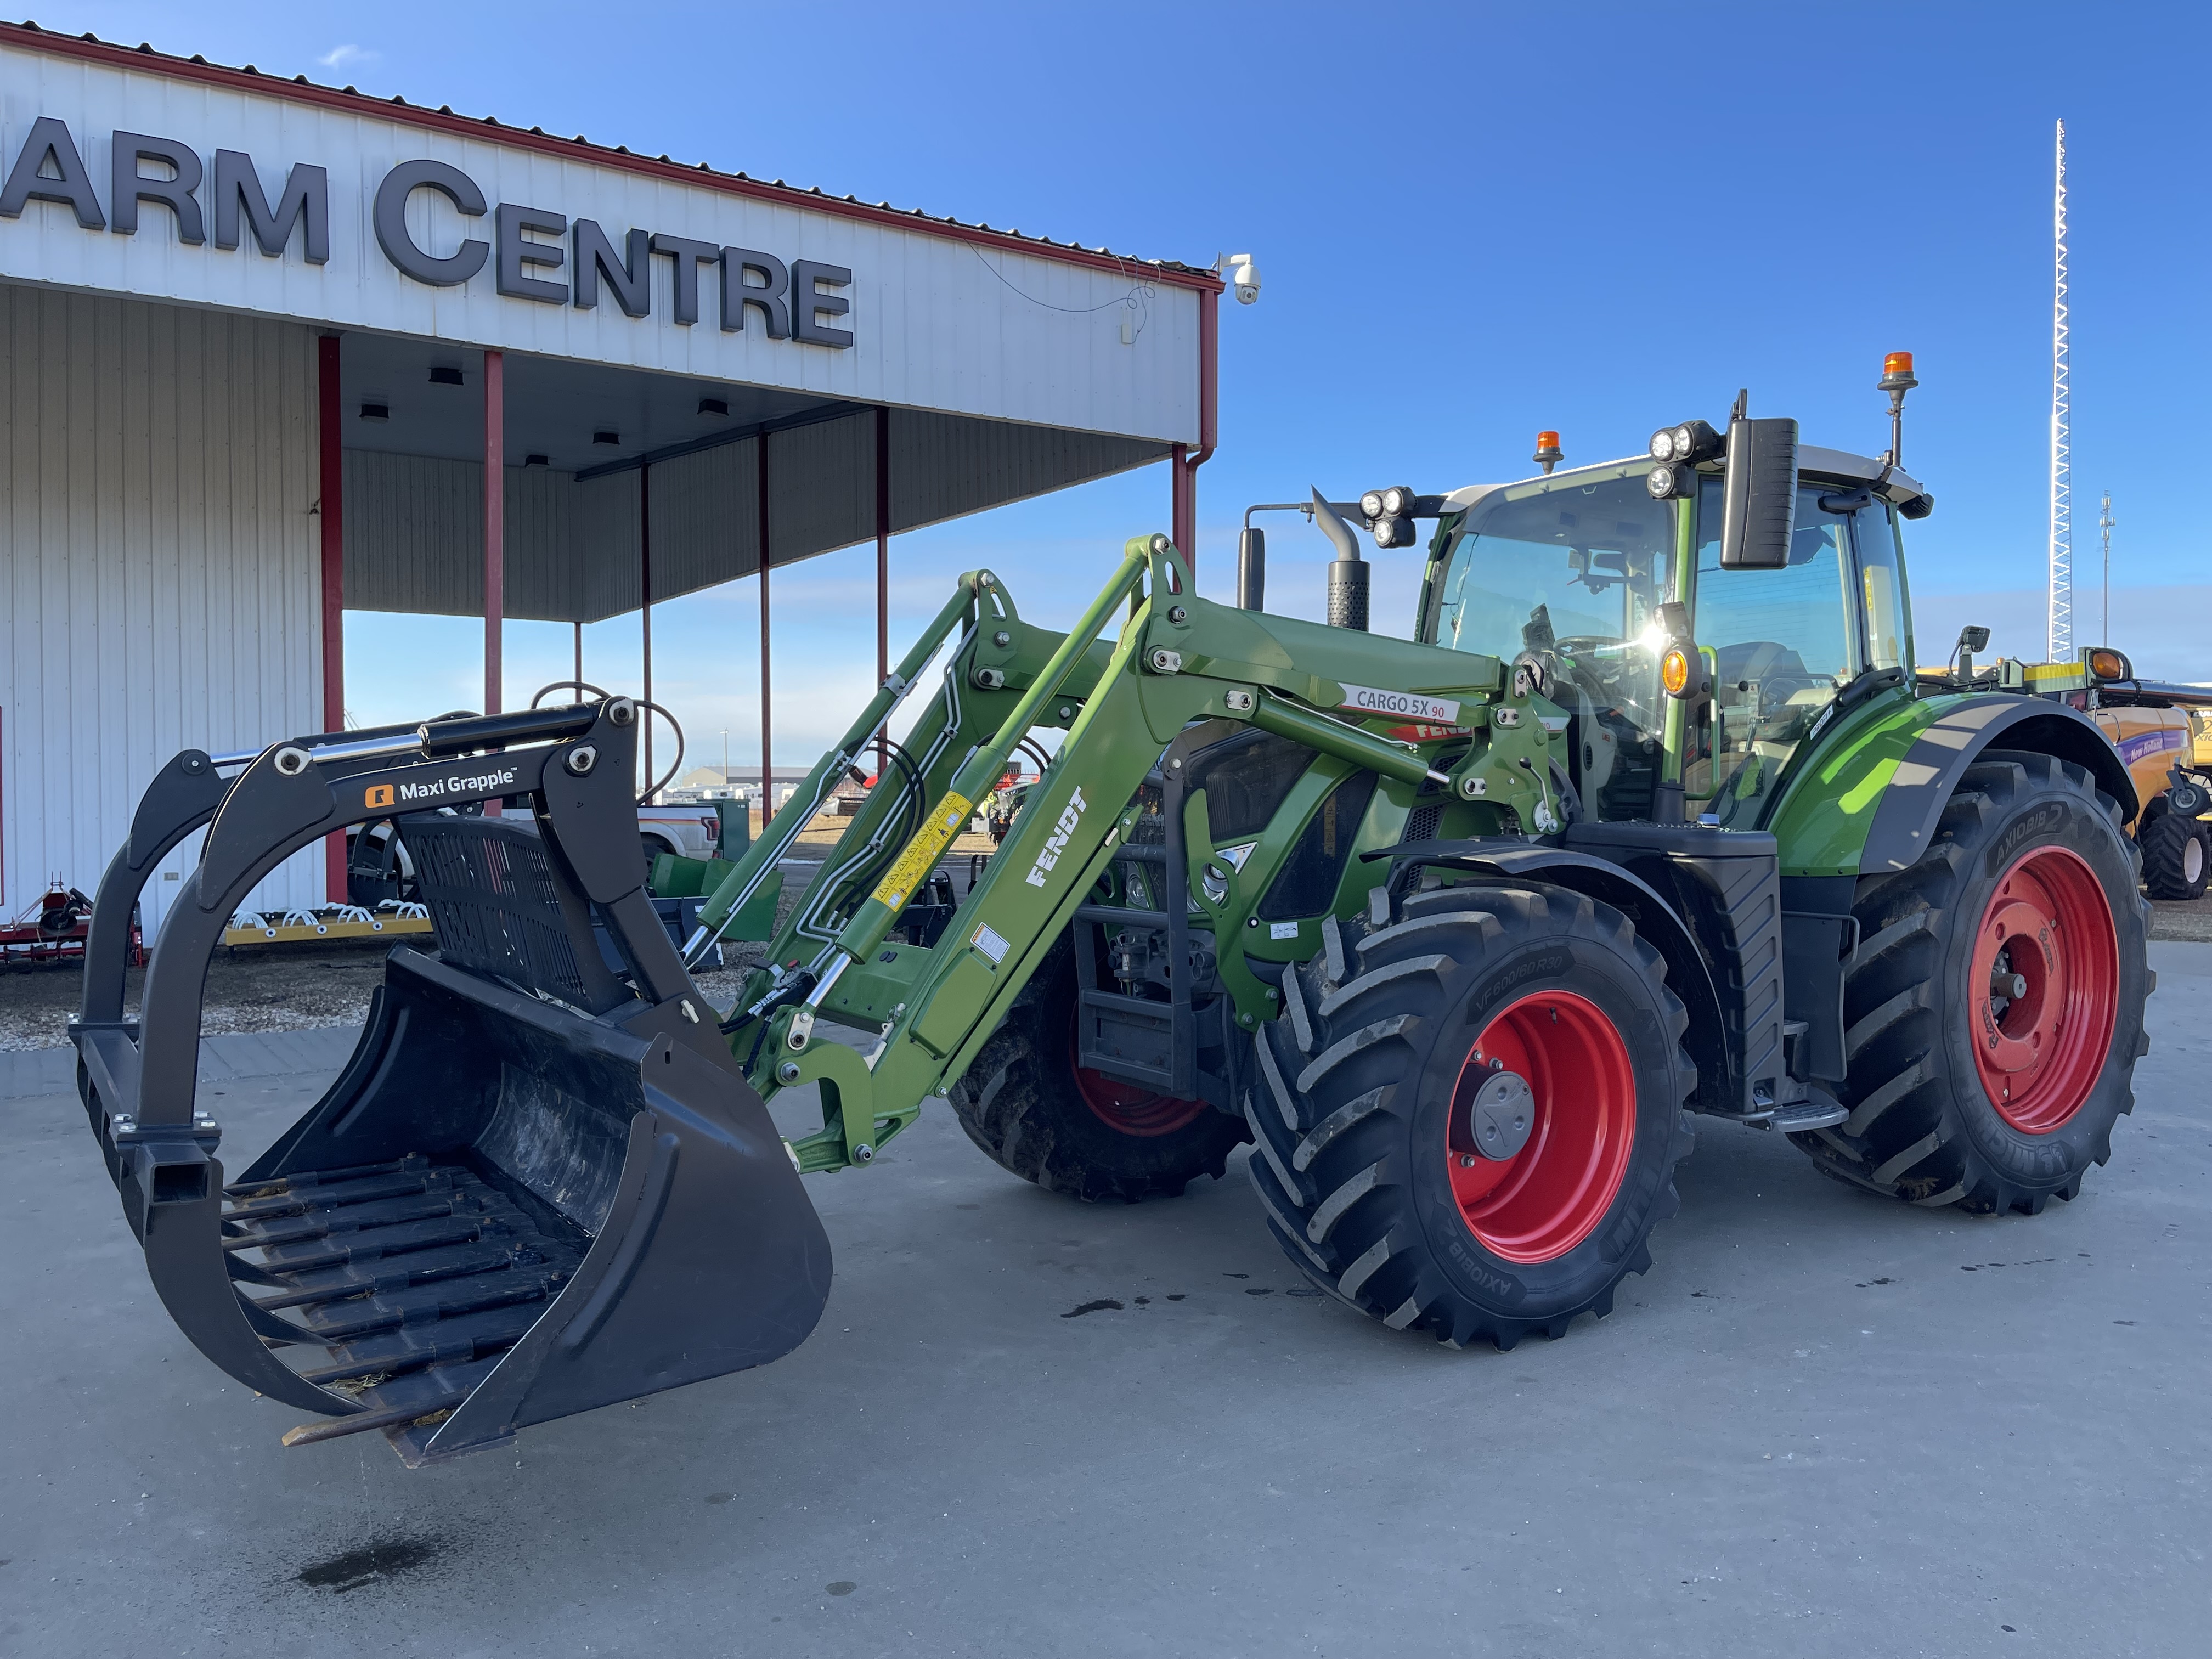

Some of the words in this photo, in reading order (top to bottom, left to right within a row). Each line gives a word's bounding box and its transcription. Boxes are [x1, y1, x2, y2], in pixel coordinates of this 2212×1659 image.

[0, 116, 329, 266] ARM
[374, 159, 854, 349] CENTRE
[1357, 691, 1408, 713] CARGO
[1411, 699, 1429, 716] 5X
[1432, 706, 1444, 718] 90
[2131, 747, 2143, 762] New
[2143, 737, 2163, 755] Holland
[400, 779, 443, 800] Maxi
[1025, 785, 1087, 888] FENDT
[1996, 810, 2047, 867] AXIOBIB
[2044, 804, 2063, 832] 2
[1449, 1241, 1512, 1296] AXIOBIB
